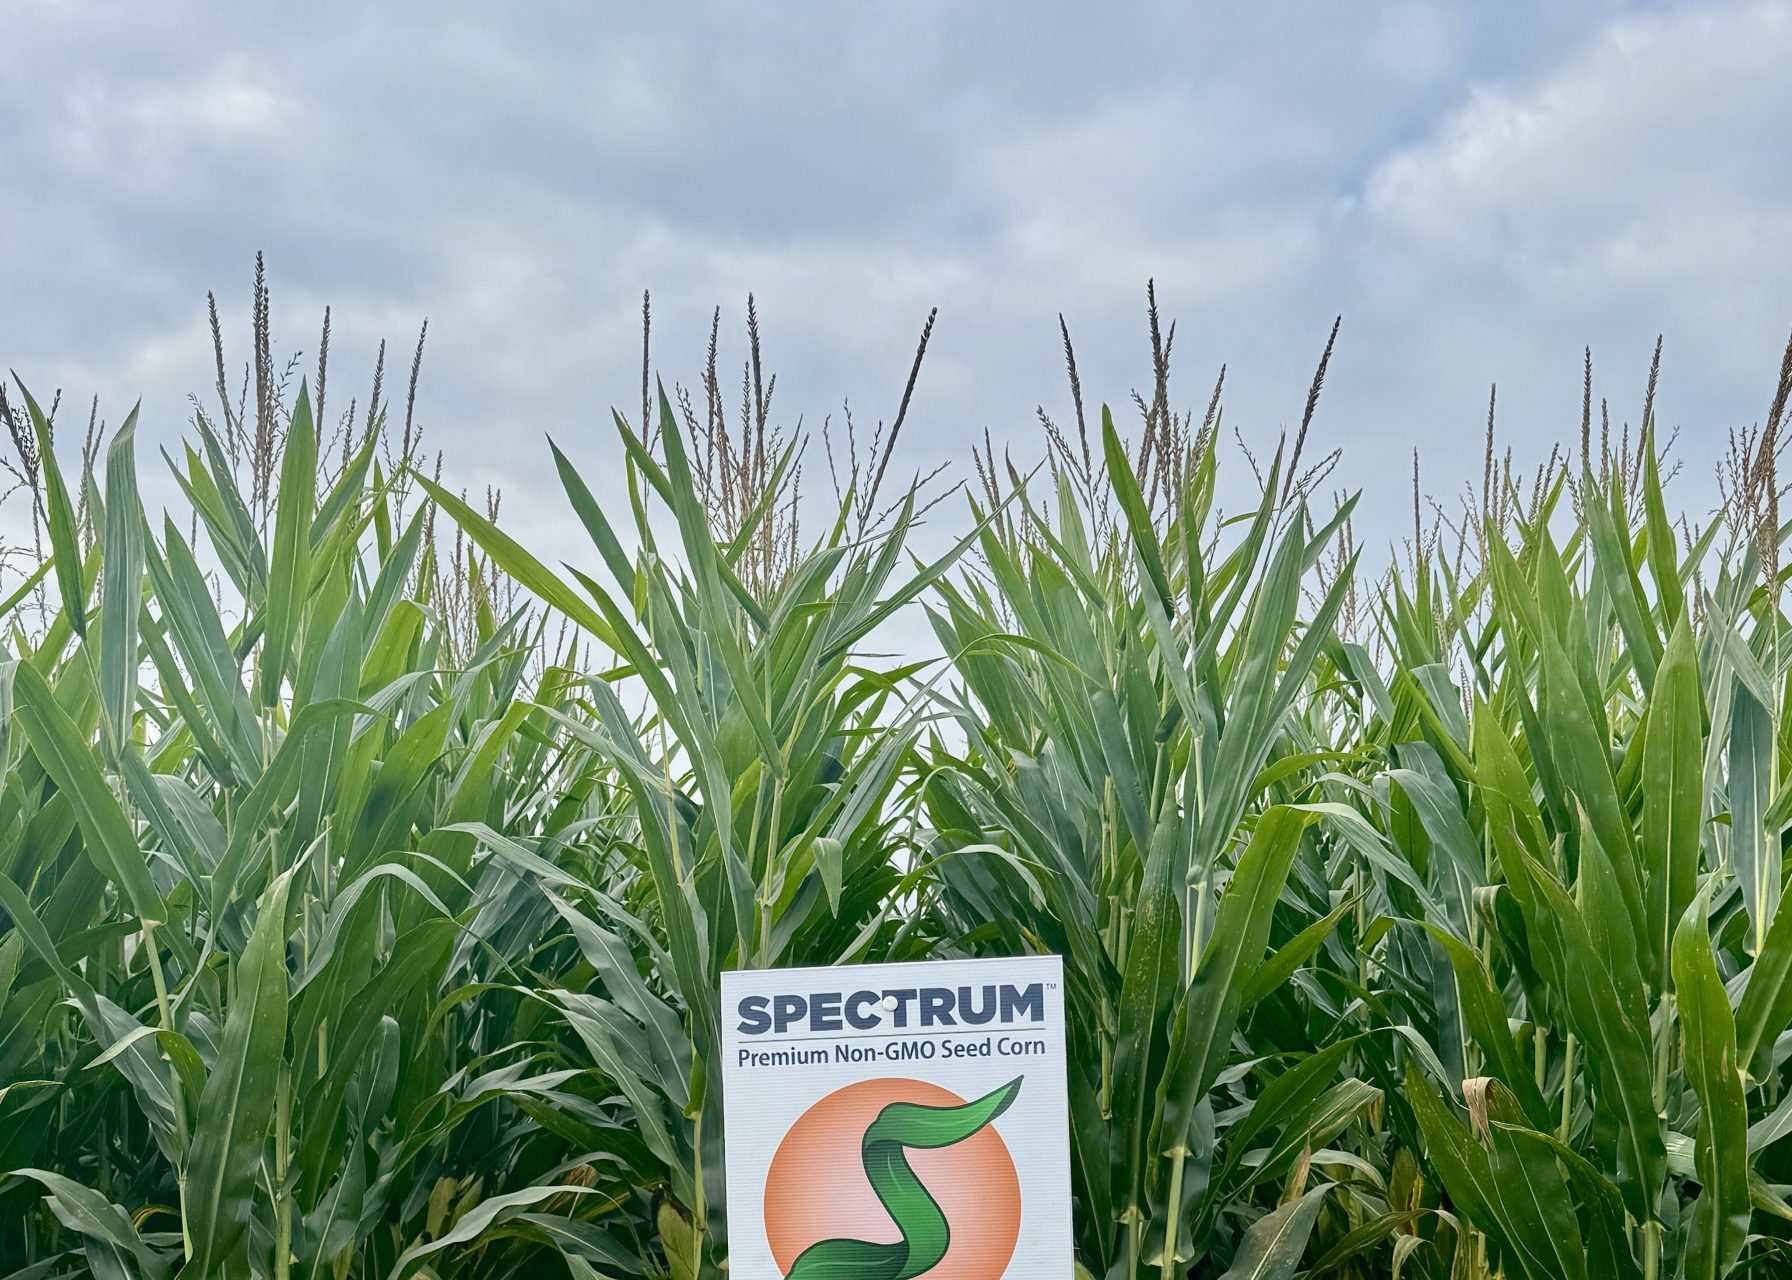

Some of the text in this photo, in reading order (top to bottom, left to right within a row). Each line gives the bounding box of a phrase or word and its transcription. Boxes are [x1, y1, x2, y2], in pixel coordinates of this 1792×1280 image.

[736, 983, 1045, 1035] SPECTRUM
[738, 1037, 1046, 1067] Premium Non-GMO Seed Corn
